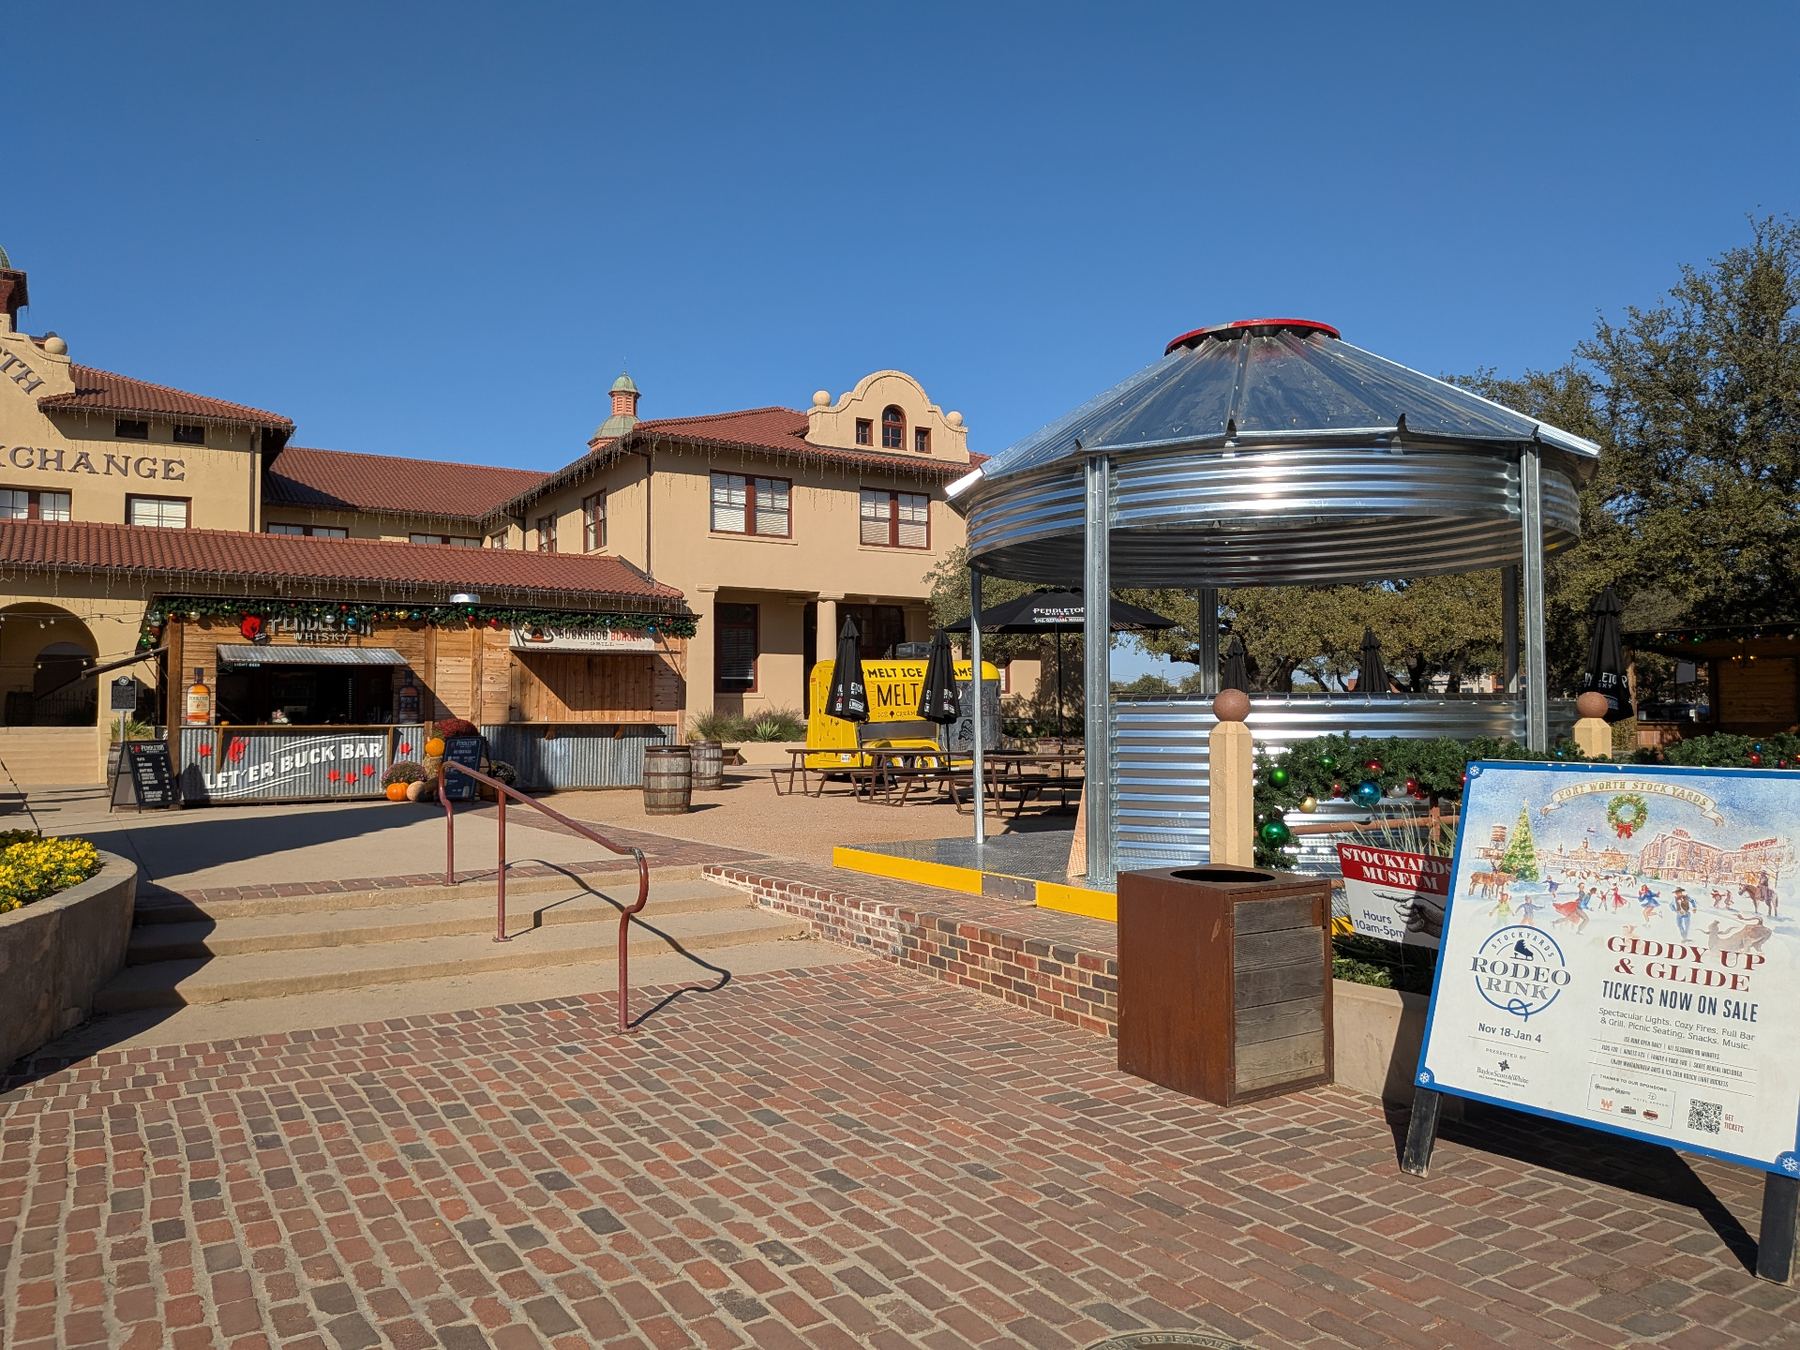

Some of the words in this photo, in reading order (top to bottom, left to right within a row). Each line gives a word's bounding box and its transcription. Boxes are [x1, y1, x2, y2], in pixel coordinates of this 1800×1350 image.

[293, 632, 349, 641] WHISKY
[867, 668, 897, 678] MELT
[901, 668, 924, 678] ICE
[877, 683, 920, 708] MELT
[280, 744, 336, 774] BUCK
[340, 742, 384, 760] BAR
[1557, 785, 1586, 800] FORT
[1589, 781, 1626, 792] WORTH
[1631, 781, 1668, 793] STOCK
[1671, 786, 1709, 806] YARDS
[1341, 847, 1452, 876] STOCKYARDS
[1361, 865, 1439, 890] MUSEUM
[1354, 919, 1406, 940] 10am-5pm
[1362, 909, 1392, 925] Hours
[1491, 931, 1555, 959] STOCKYARDS
[1607, 935, 1709, 964] GIDDY
[1718, 949, 1766, 971] UP
[1469, 956, 1571, 986] RODEO
[1613, 957, 1636, 975] &
[1645, 962, 1751, 993] GLIDE
[1485, 976, 1549, 1000] RINK
[1602, 980, 1655, 1005] TICKETS
[1659, 989, 1693, 1012] NOW
[1697, 995, 1717, 1016] ON
[1722, 999, 1759, 1023] SALE
[1478, 1022, 1497, 1034] Nov
[1500, 1027, 1532, 1042] 18-Jan
[1535, 1034, 1542, 1043] 4
[1598, 1007, 1643, 1020] Spectacular
[1674, 1020, 1694, 1031] Cozy
[1721, 1028, 1737, 1038] Full
[1739, 1031, 1756, 1041] Bar
[1628, 1021, 1651, 1032] Picnic
[1139, 1335, 1164, 1344] OF
